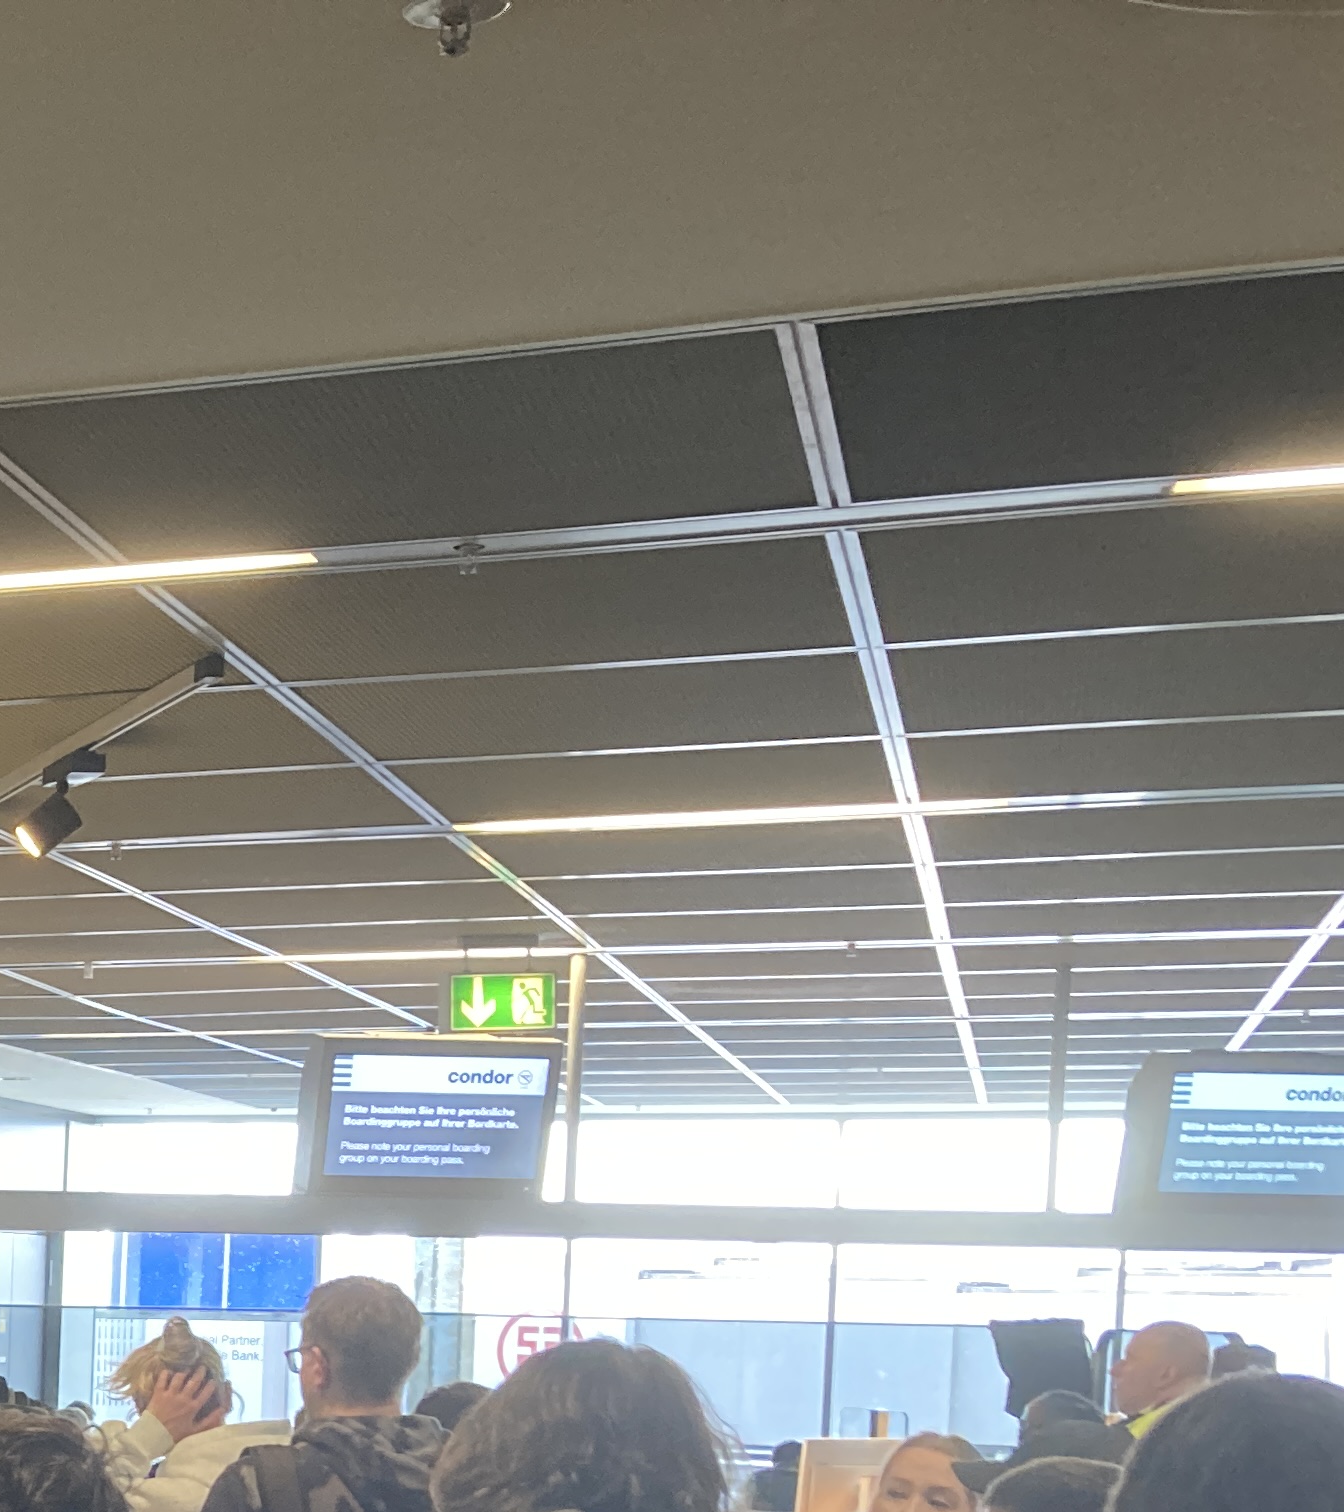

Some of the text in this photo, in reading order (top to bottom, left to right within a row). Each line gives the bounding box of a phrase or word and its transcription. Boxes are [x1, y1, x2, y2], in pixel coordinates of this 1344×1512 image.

[448, 1069, 514, 1085] condor
[1286, 1086, 1344, 1102] condo
[392, 1144, 412, 1153] your
[339, 1155, 365, 1165] group
[380, 1156, 399, 1165] your
